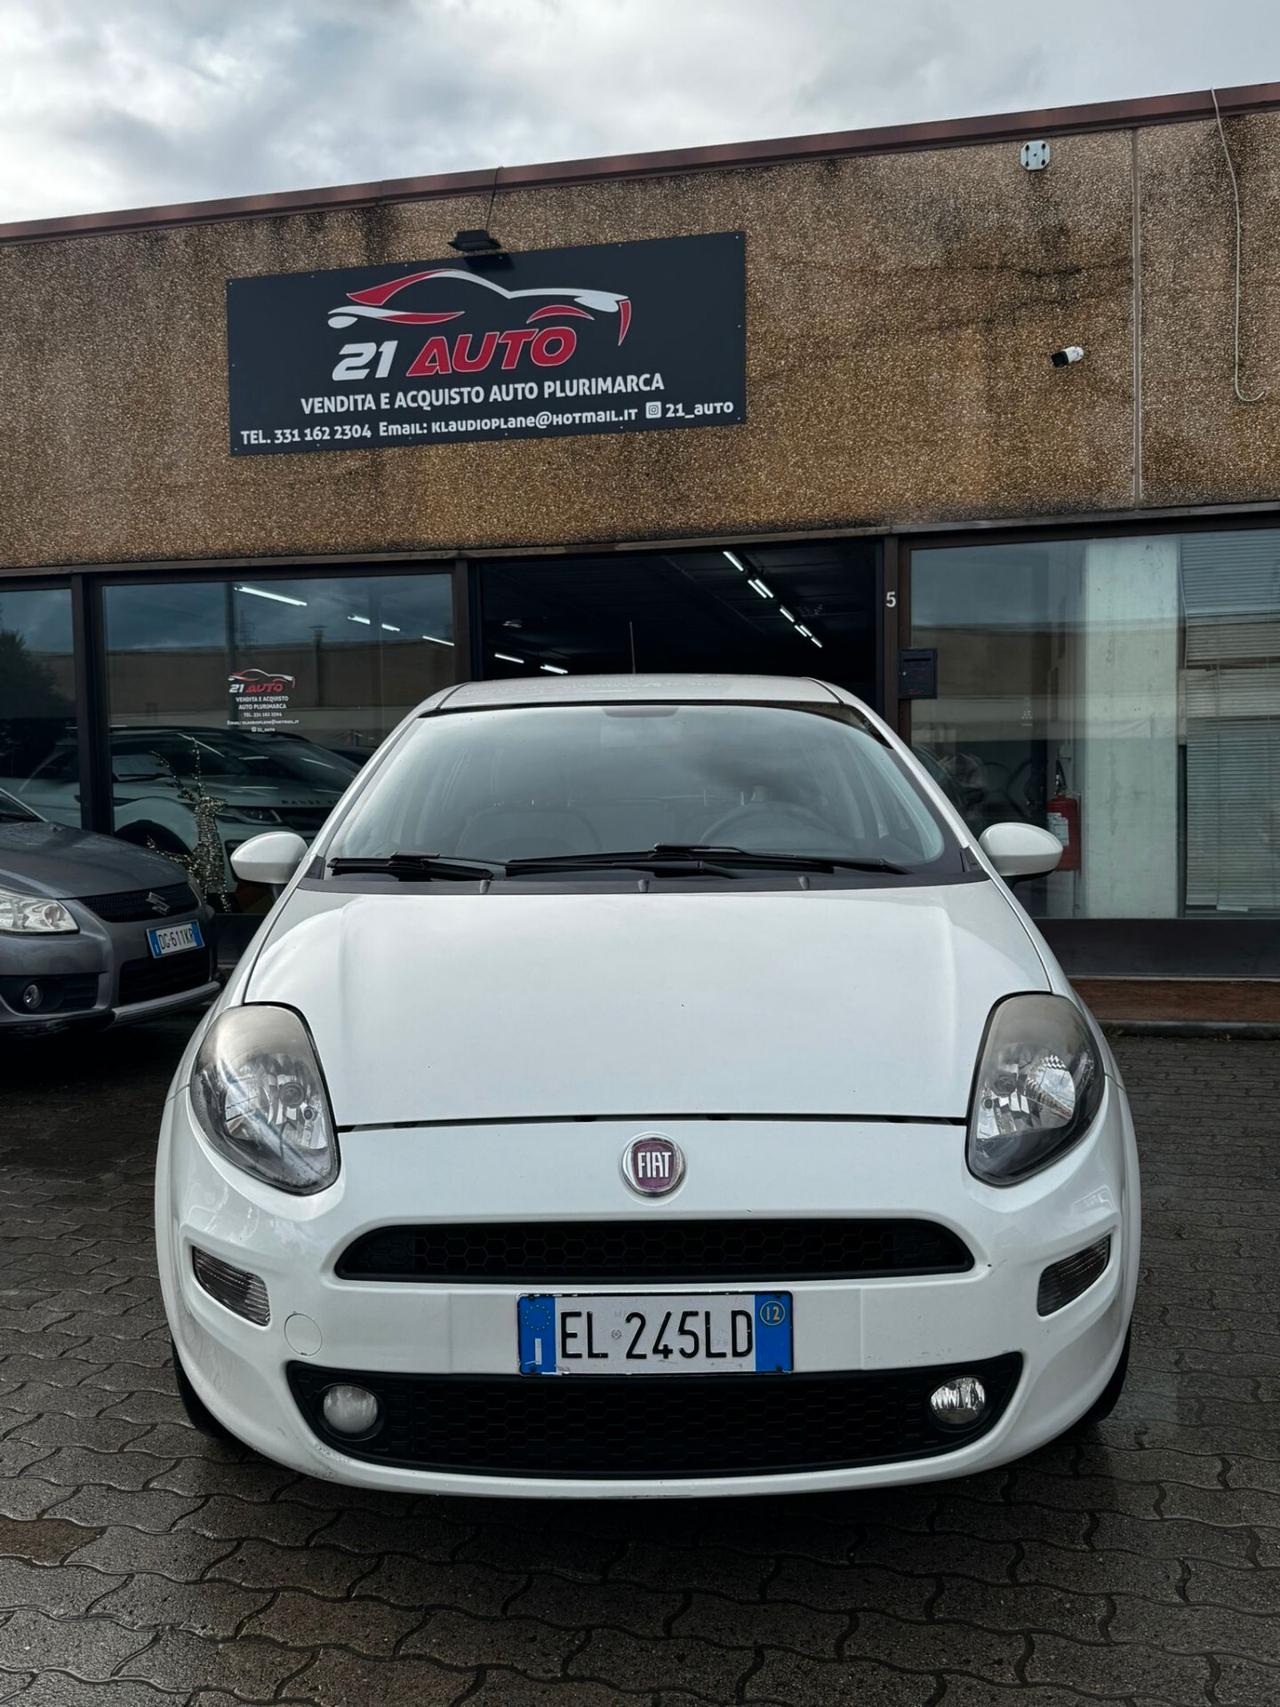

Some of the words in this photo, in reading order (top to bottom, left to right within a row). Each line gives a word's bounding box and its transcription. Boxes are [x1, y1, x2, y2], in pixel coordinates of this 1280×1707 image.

[332, 340, 398, 381] 21
[406, 326, 577, 377] AUTO
[300, 393, 376, 414] VENDITA
[380, 392, 390, 409] E
[394, 386, 485, 411] ACQUISTO
[489, 382, 538, 402] AUTO
[543, 372, 665, 398] PLURIMARCA
[240, 430, 271, 445] TEL.
[274, 428, 301, 444] 331
[304, 426, 331, 441] 162
[334, 424, 372, 439] 2304
[886, 591, 896, 607] 5
[229, 684, 245, 693] 21
[246, 683, 284, 693] AUTO
[262, 695, 289, 703] ACQUISTO
[637, 1151, 672, 1178] FIAT
[765, 1306, 780, 1322] 12
[560, 1311, 608, 1359] EL
[625, 1310, 753, 1359] 245LD
